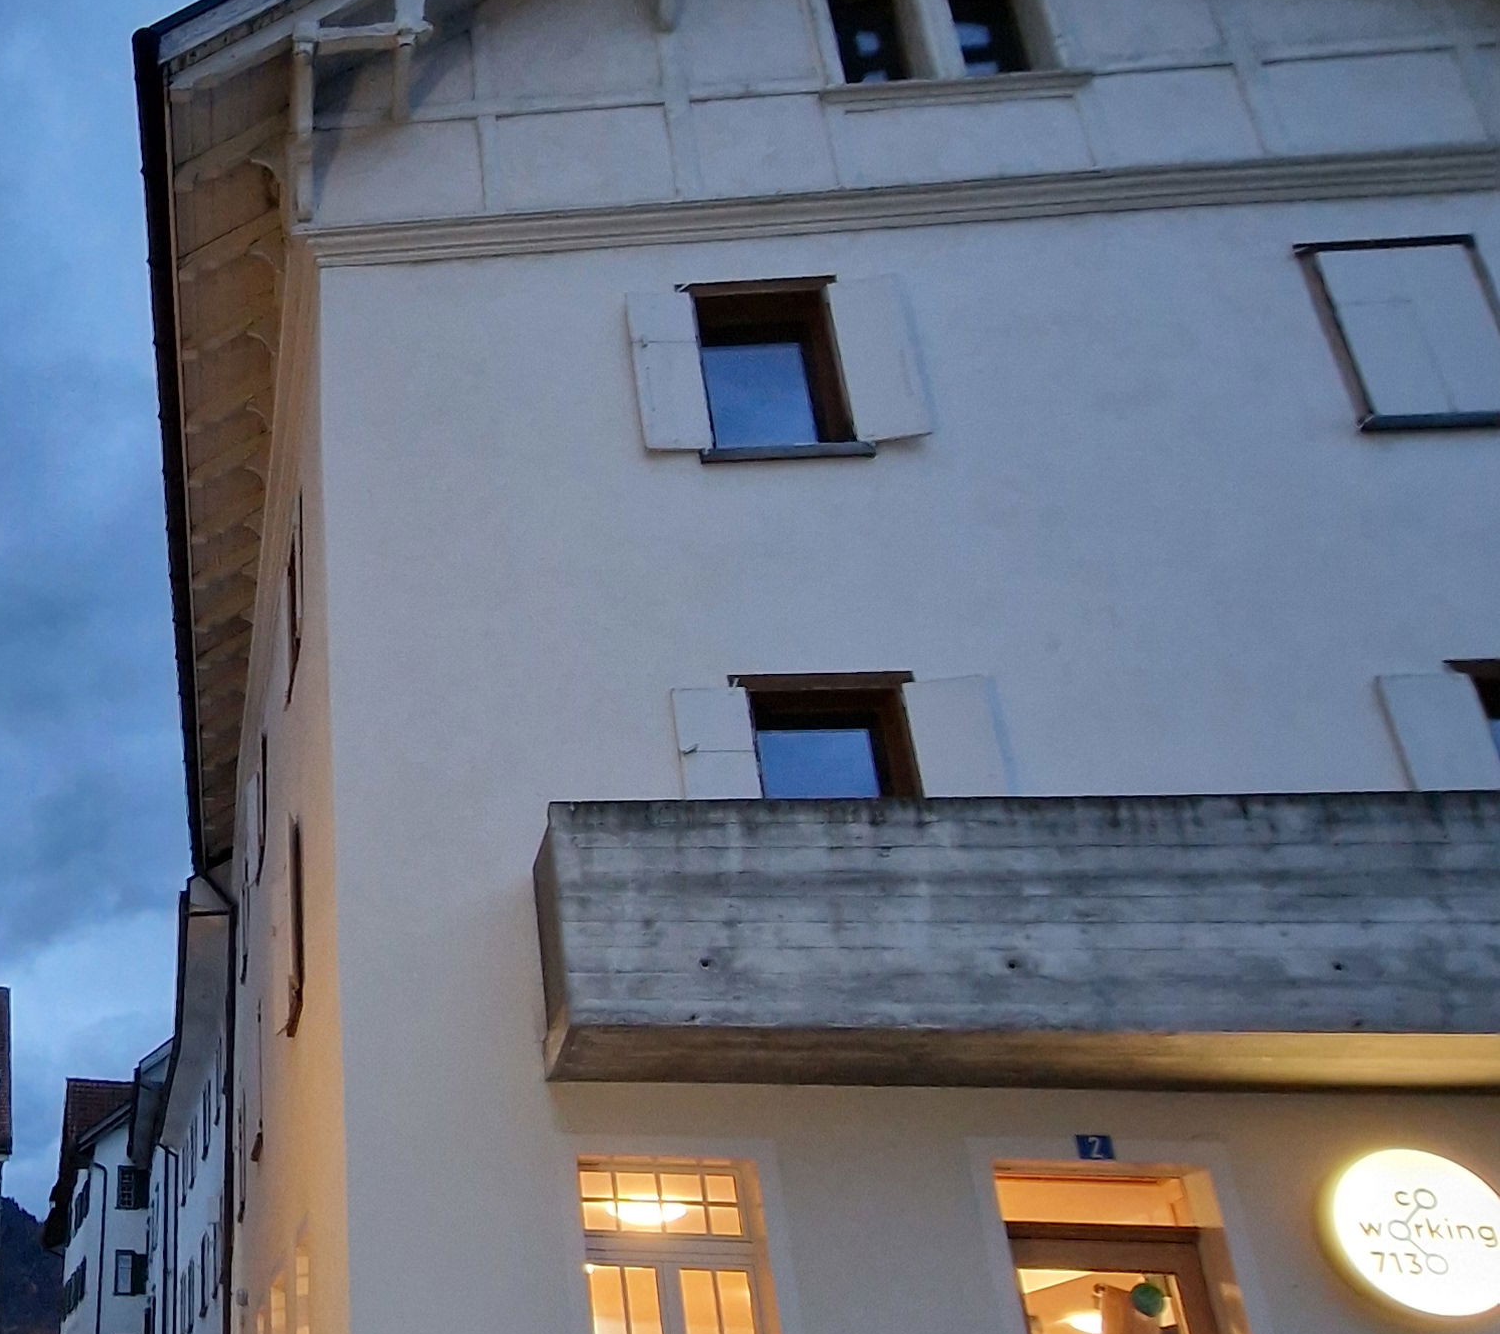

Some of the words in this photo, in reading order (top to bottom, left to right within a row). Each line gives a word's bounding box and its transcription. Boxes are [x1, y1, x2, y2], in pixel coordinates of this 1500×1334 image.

[1087, 1136, 1104, 1158] 2
[1394, 1188, 1438, 1210] co
[1359, 1217, 1498, 1248] working
[1369, 1251, 1449, 1275] 7130
